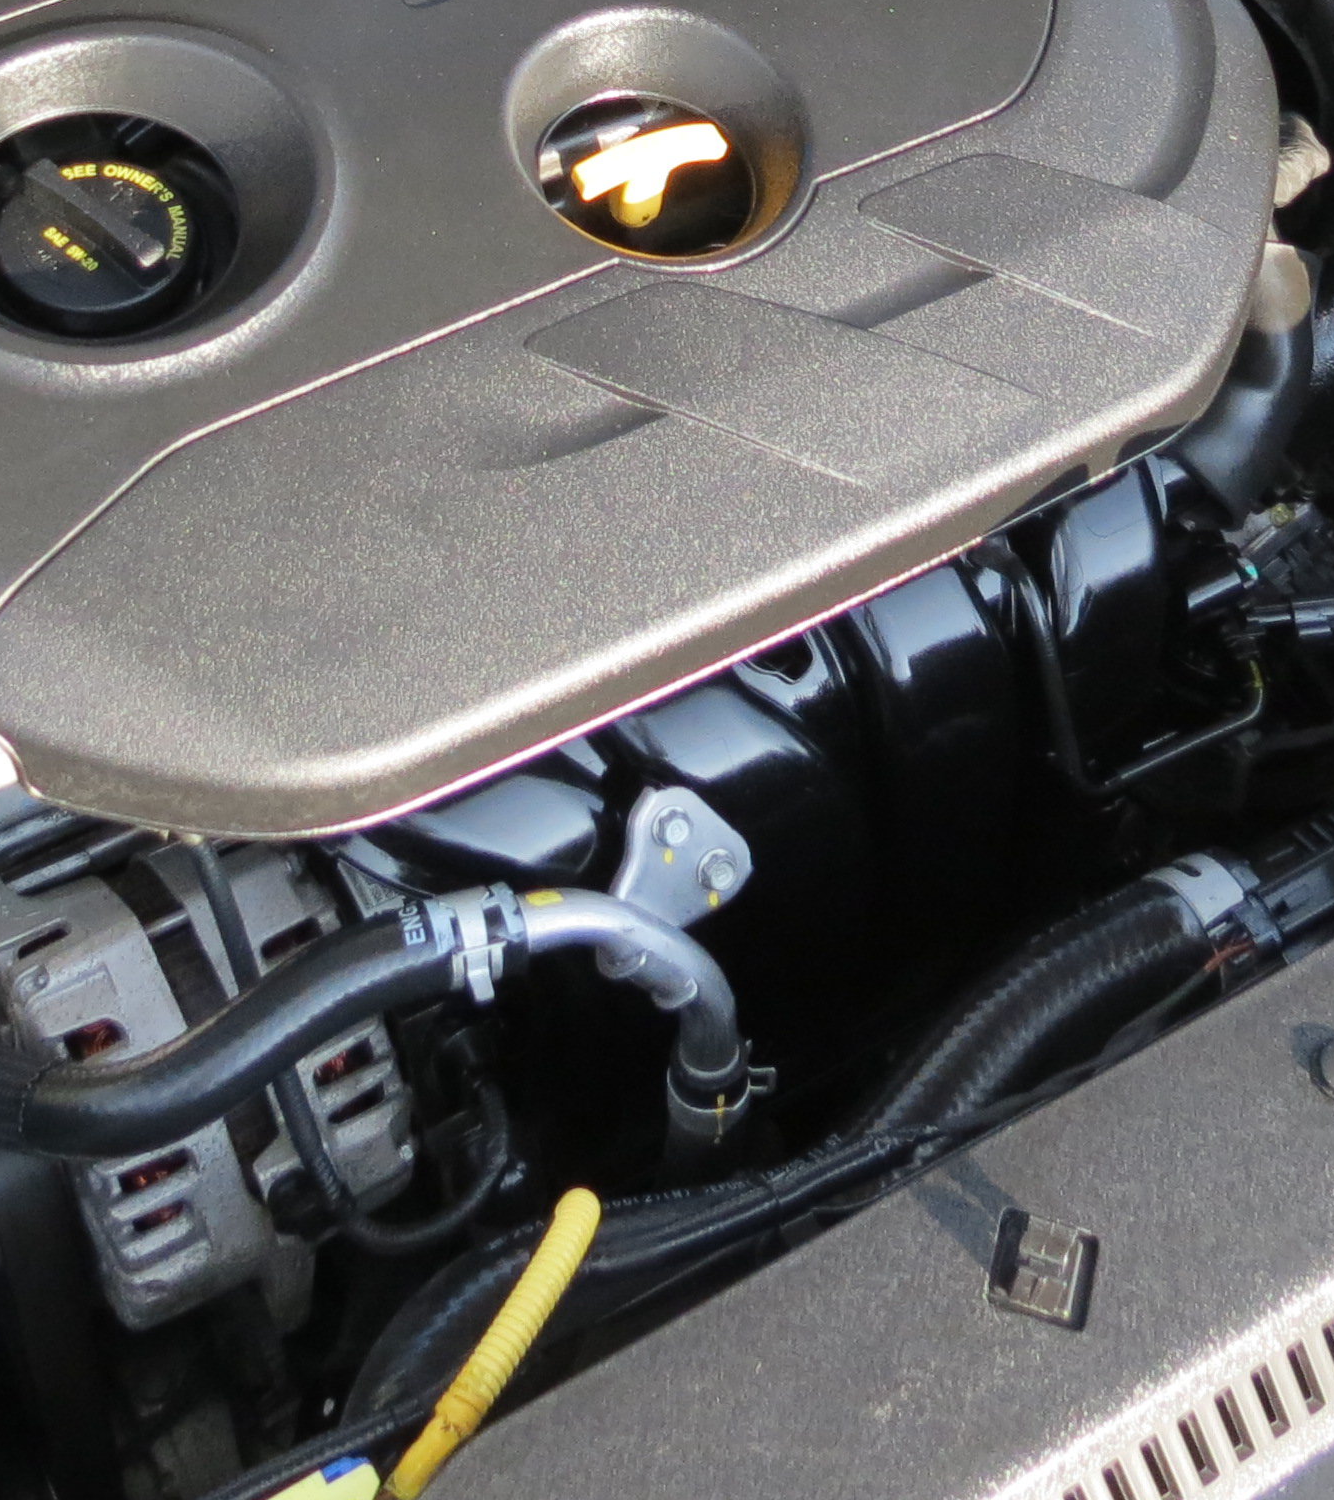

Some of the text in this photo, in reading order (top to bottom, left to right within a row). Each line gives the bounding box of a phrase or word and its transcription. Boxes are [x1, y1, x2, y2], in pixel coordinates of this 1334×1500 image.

[60, 163, 188, 260] SEE OWNER'S MANUAL
[42, 226, 70, 248] SAE
[65, 244, 100, 272] 5W-20
